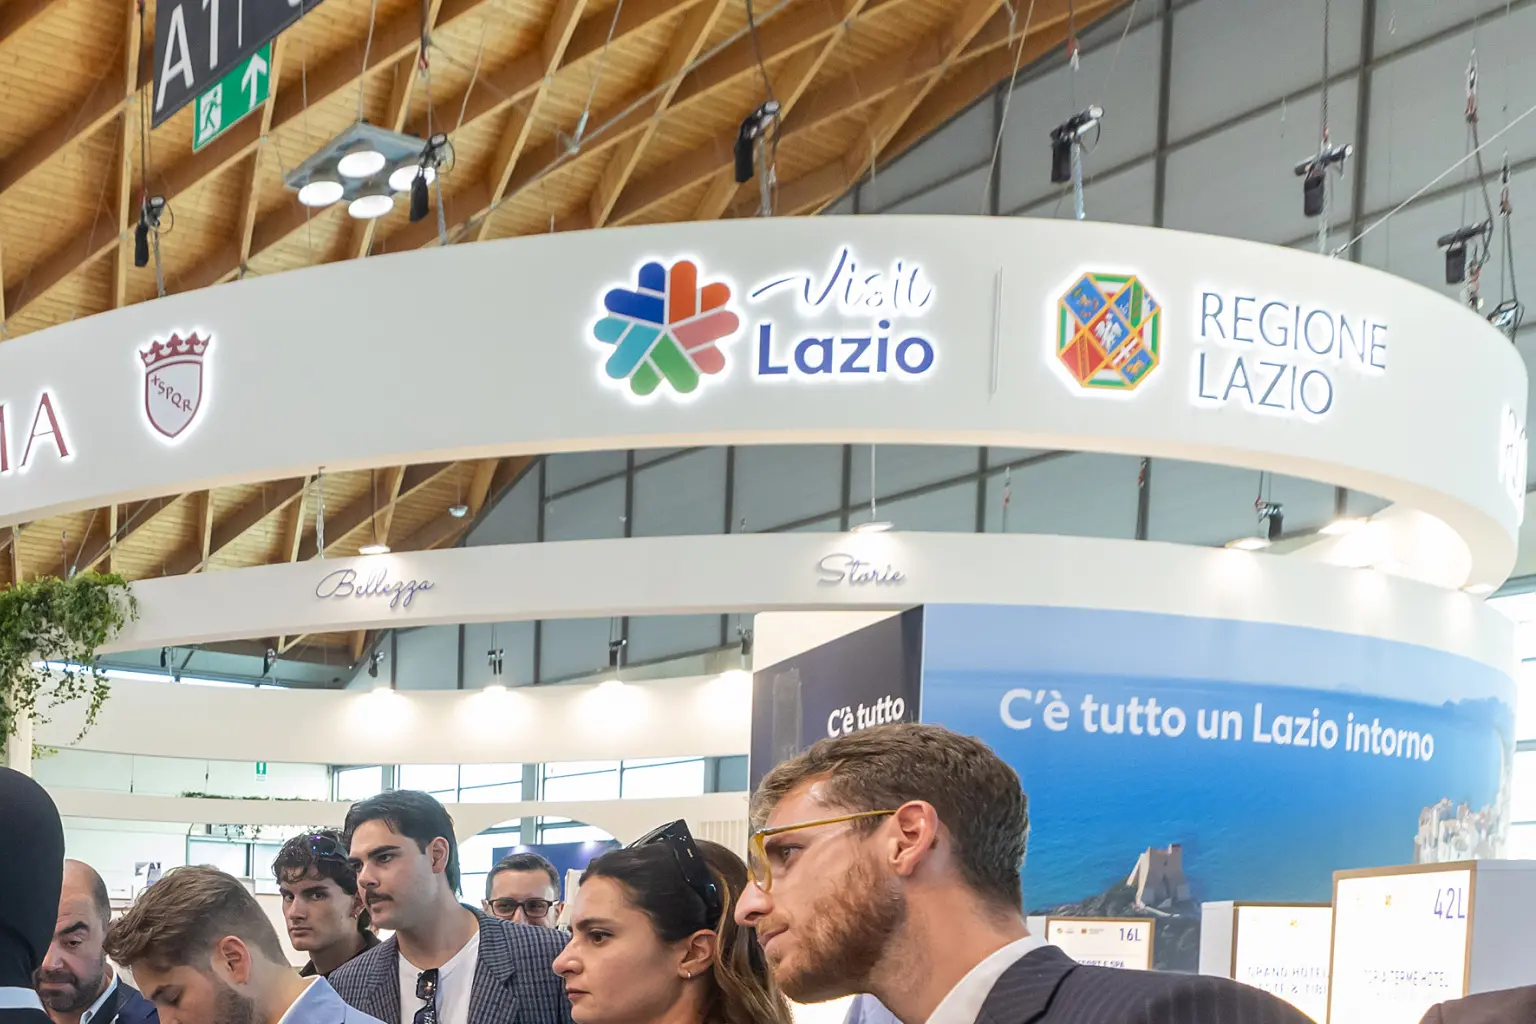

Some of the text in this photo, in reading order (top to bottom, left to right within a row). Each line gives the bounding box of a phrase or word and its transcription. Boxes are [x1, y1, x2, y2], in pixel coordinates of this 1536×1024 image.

[758, 318, 935, 376] Lazio
[1200, 291, 1388, 371] REGIONE
[157, 379, 192, 413] SPQR
[1198, 351, 1334, 415] LAZIO
[315, 567, 435, 609] Bellezza
[817, 552, 906, 587] Storie
[827, 694, 906, 738] C'è tutto
[999, 688, 1435, 762] C'è tutto un Lazio intorno
[1434, 887, 1466, 920] 42L
[1119, 927, 1142, 942] 16L
